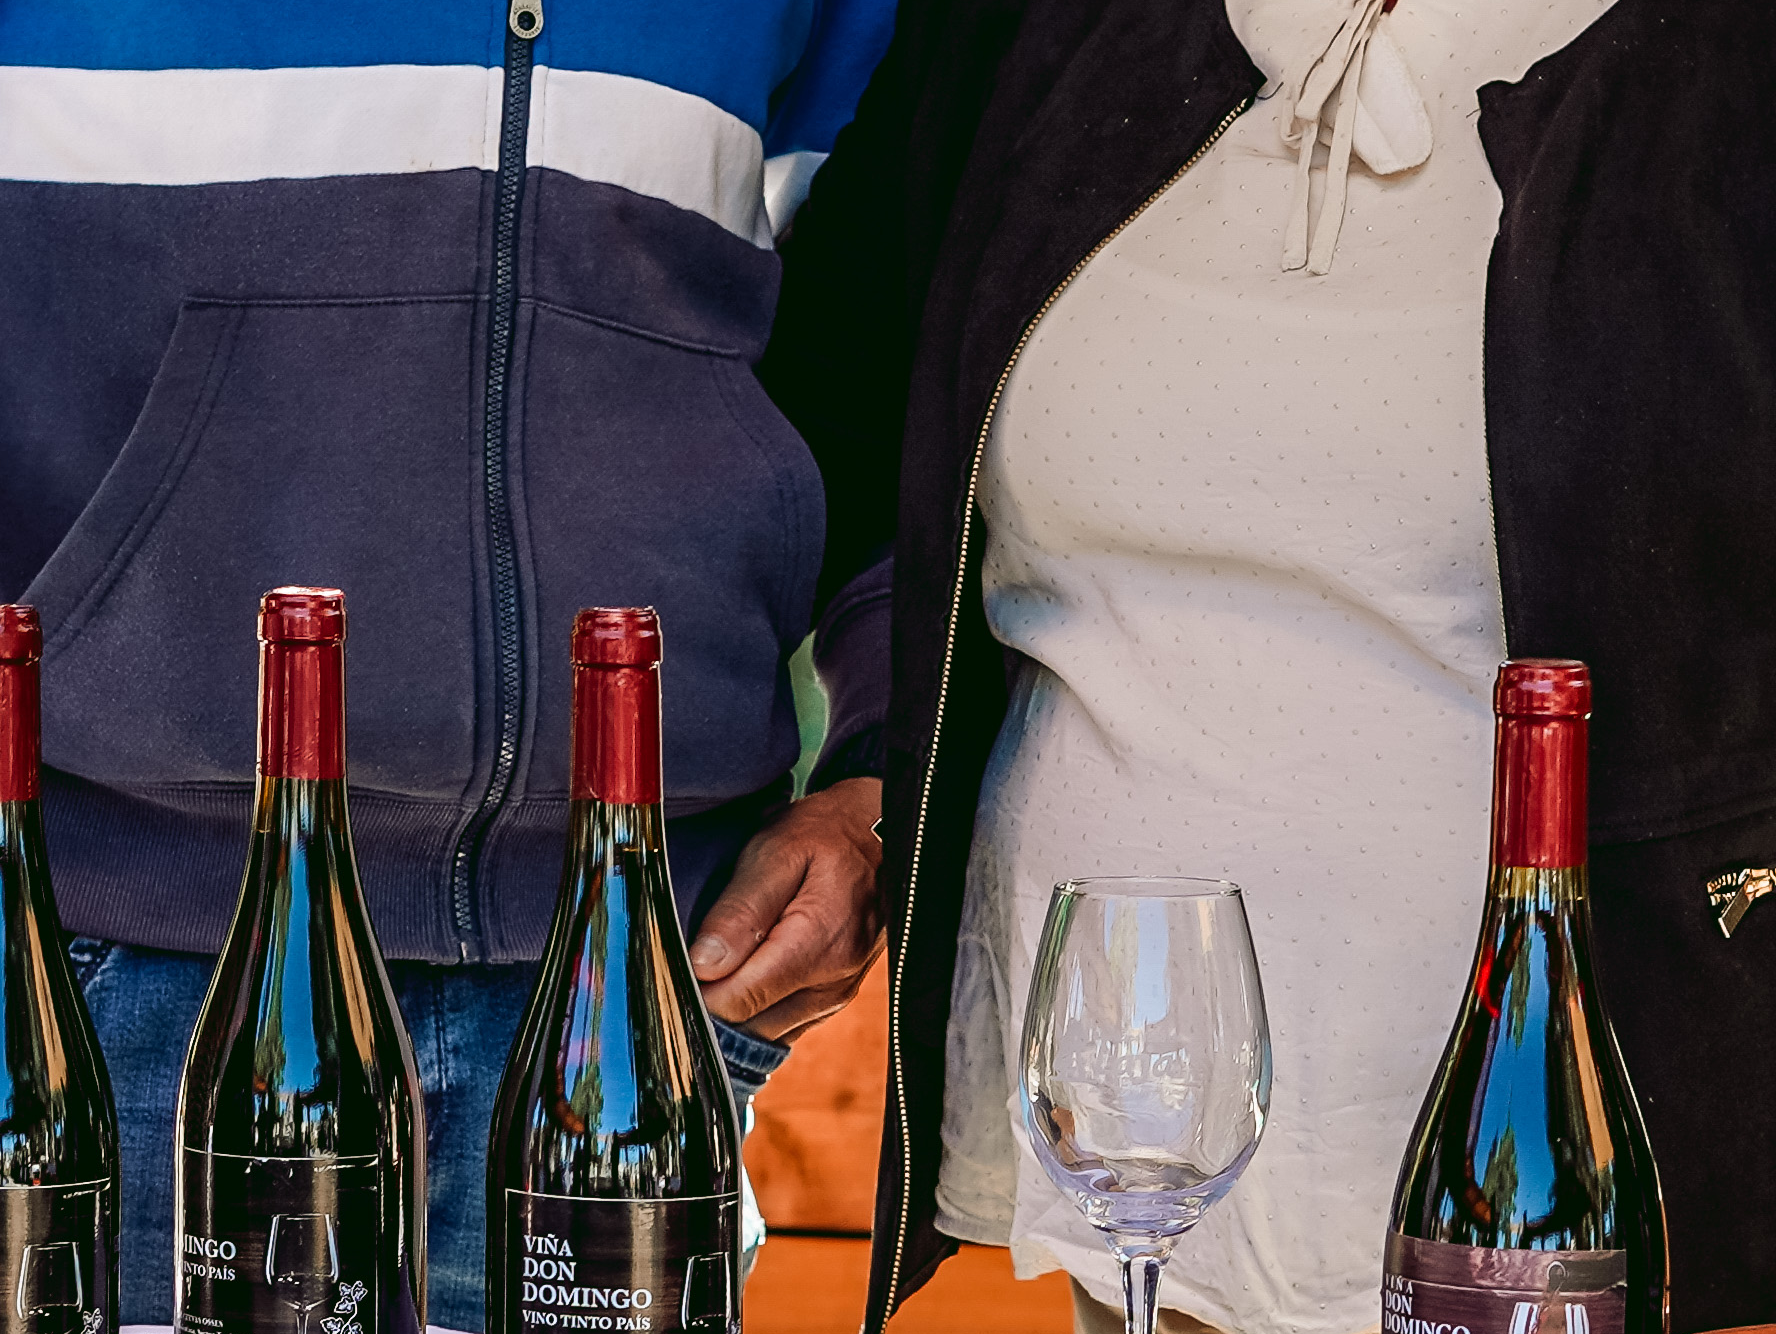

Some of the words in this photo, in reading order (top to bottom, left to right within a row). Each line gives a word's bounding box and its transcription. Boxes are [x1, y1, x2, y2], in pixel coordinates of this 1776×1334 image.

[524, 1233, 573, 1257] VIÑA
[208, 1264, 236, 1281] PAÍS
[523, 1257, 577, 1281] DON
[522, 1281, 653, 1309] DOMINGO
[1385, 1289, 1413, 1315] DON
[522, 1309, 558, 1326] VINO
[560, 1314, 613, 1330] TINTO
[615, 1314, 651, 1331] PAÍS
